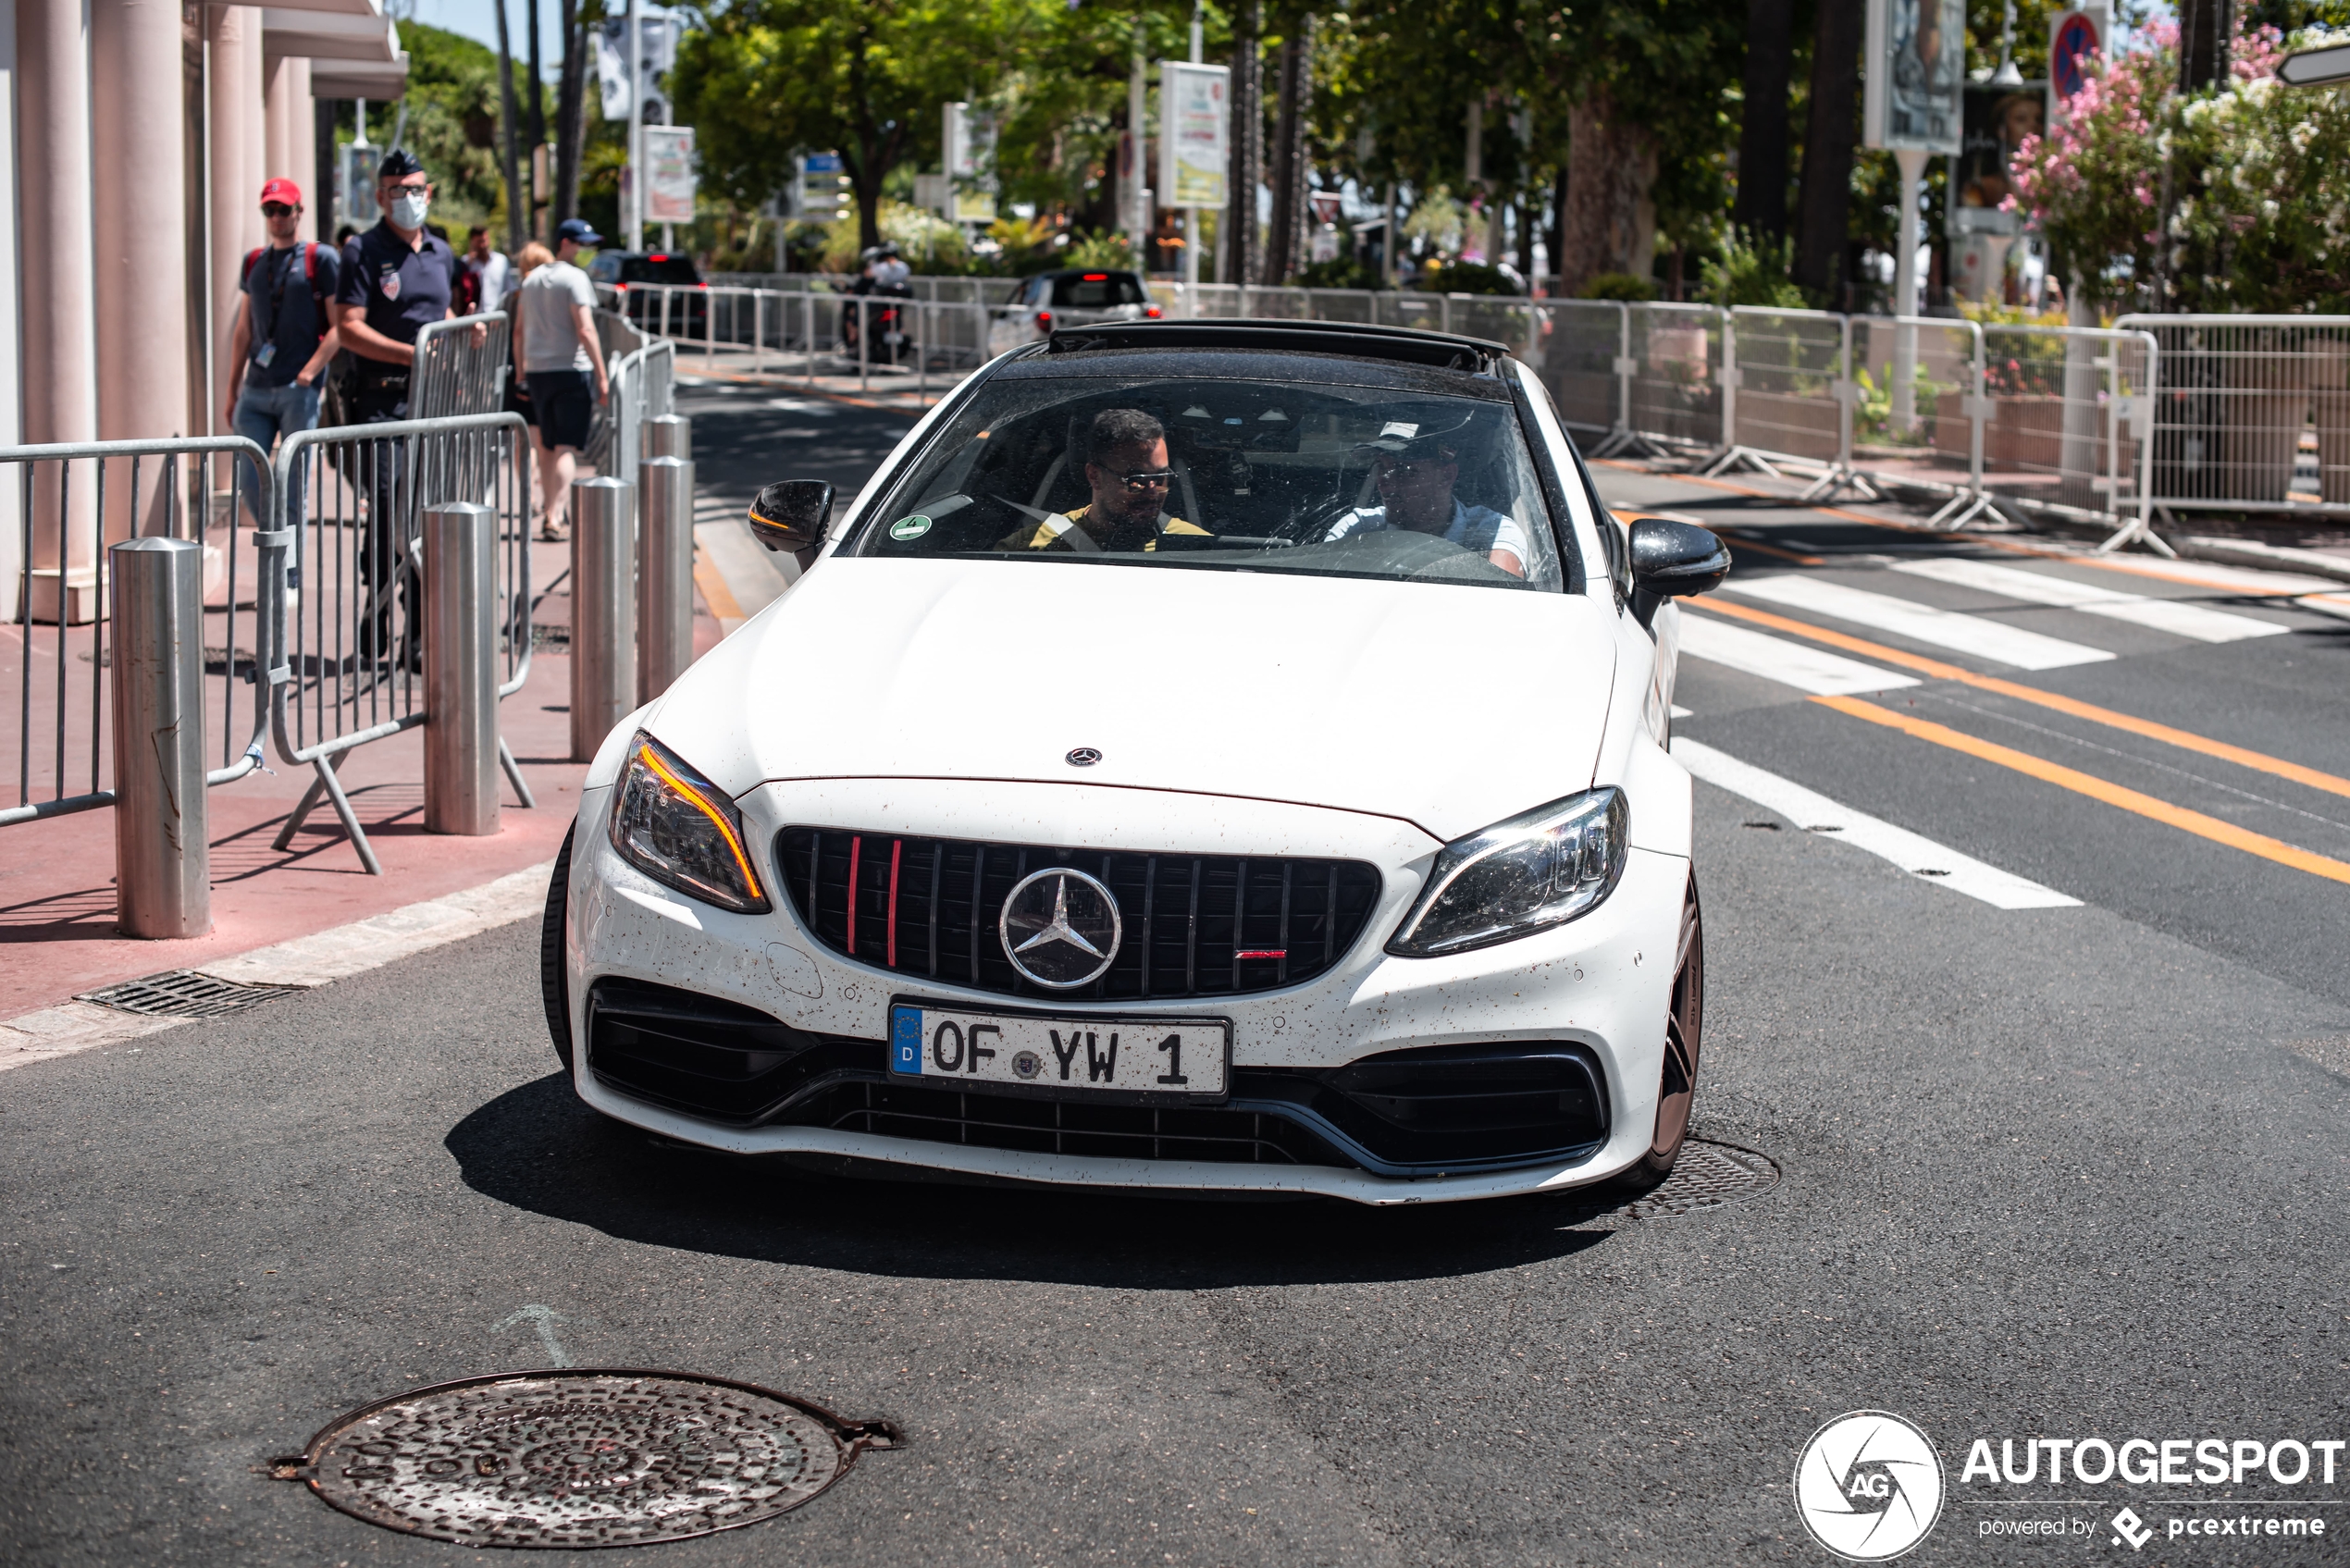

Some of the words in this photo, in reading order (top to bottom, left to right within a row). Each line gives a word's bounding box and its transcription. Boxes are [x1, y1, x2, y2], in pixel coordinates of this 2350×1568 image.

[906, 517, 917, 527] 4
[902, 1046, 913, 1061] D
[933, 1019, 1000, 1073] OF
[1049, 1029, 1119, 1082] YW
[1157, 1034, 1188, 1084] 1
